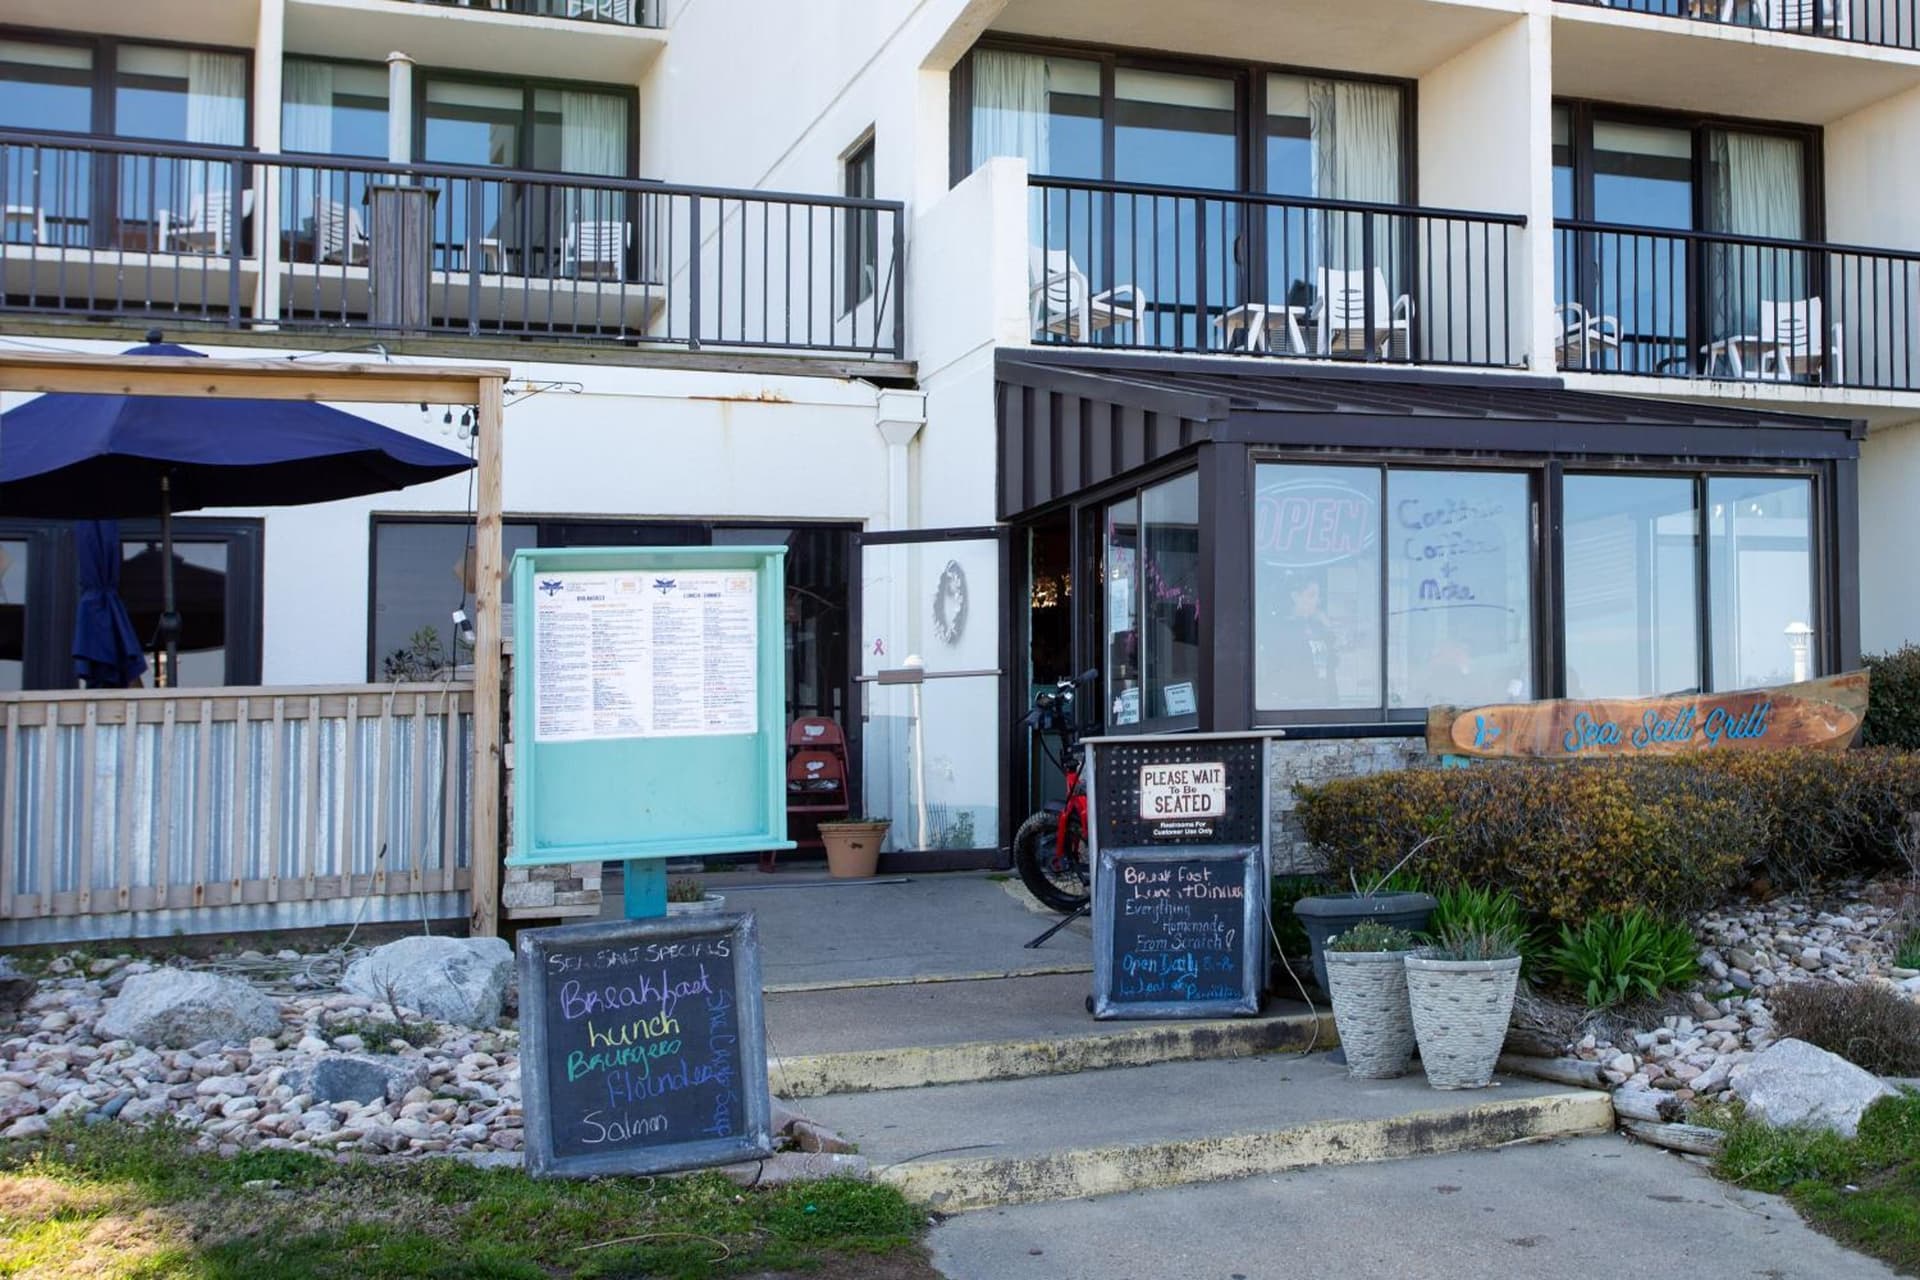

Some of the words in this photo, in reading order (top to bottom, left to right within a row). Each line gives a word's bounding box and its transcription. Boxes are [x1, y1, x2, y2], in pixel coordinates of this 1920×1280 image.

[1255, 497, 1368, 553] OPEN
[1563, 712, 1622, 752] Sea
[1632, 705, 1697, 749] Salt
[1704, 701, 1771, 748] Grill
[1144, 770, 1188, 786] PLEASE
[1192, 769, 1221, 784] WAIT
[1168, 786, 1180, 794] To
[1183, 785, 1197, 794] Be
[1154, 794, 1212, 813] SEATED
[1198, 828, 1213, 836] Only
[1122, 953, 1157, 976] Open
[582, 1109, 668, 1144] Salmon
